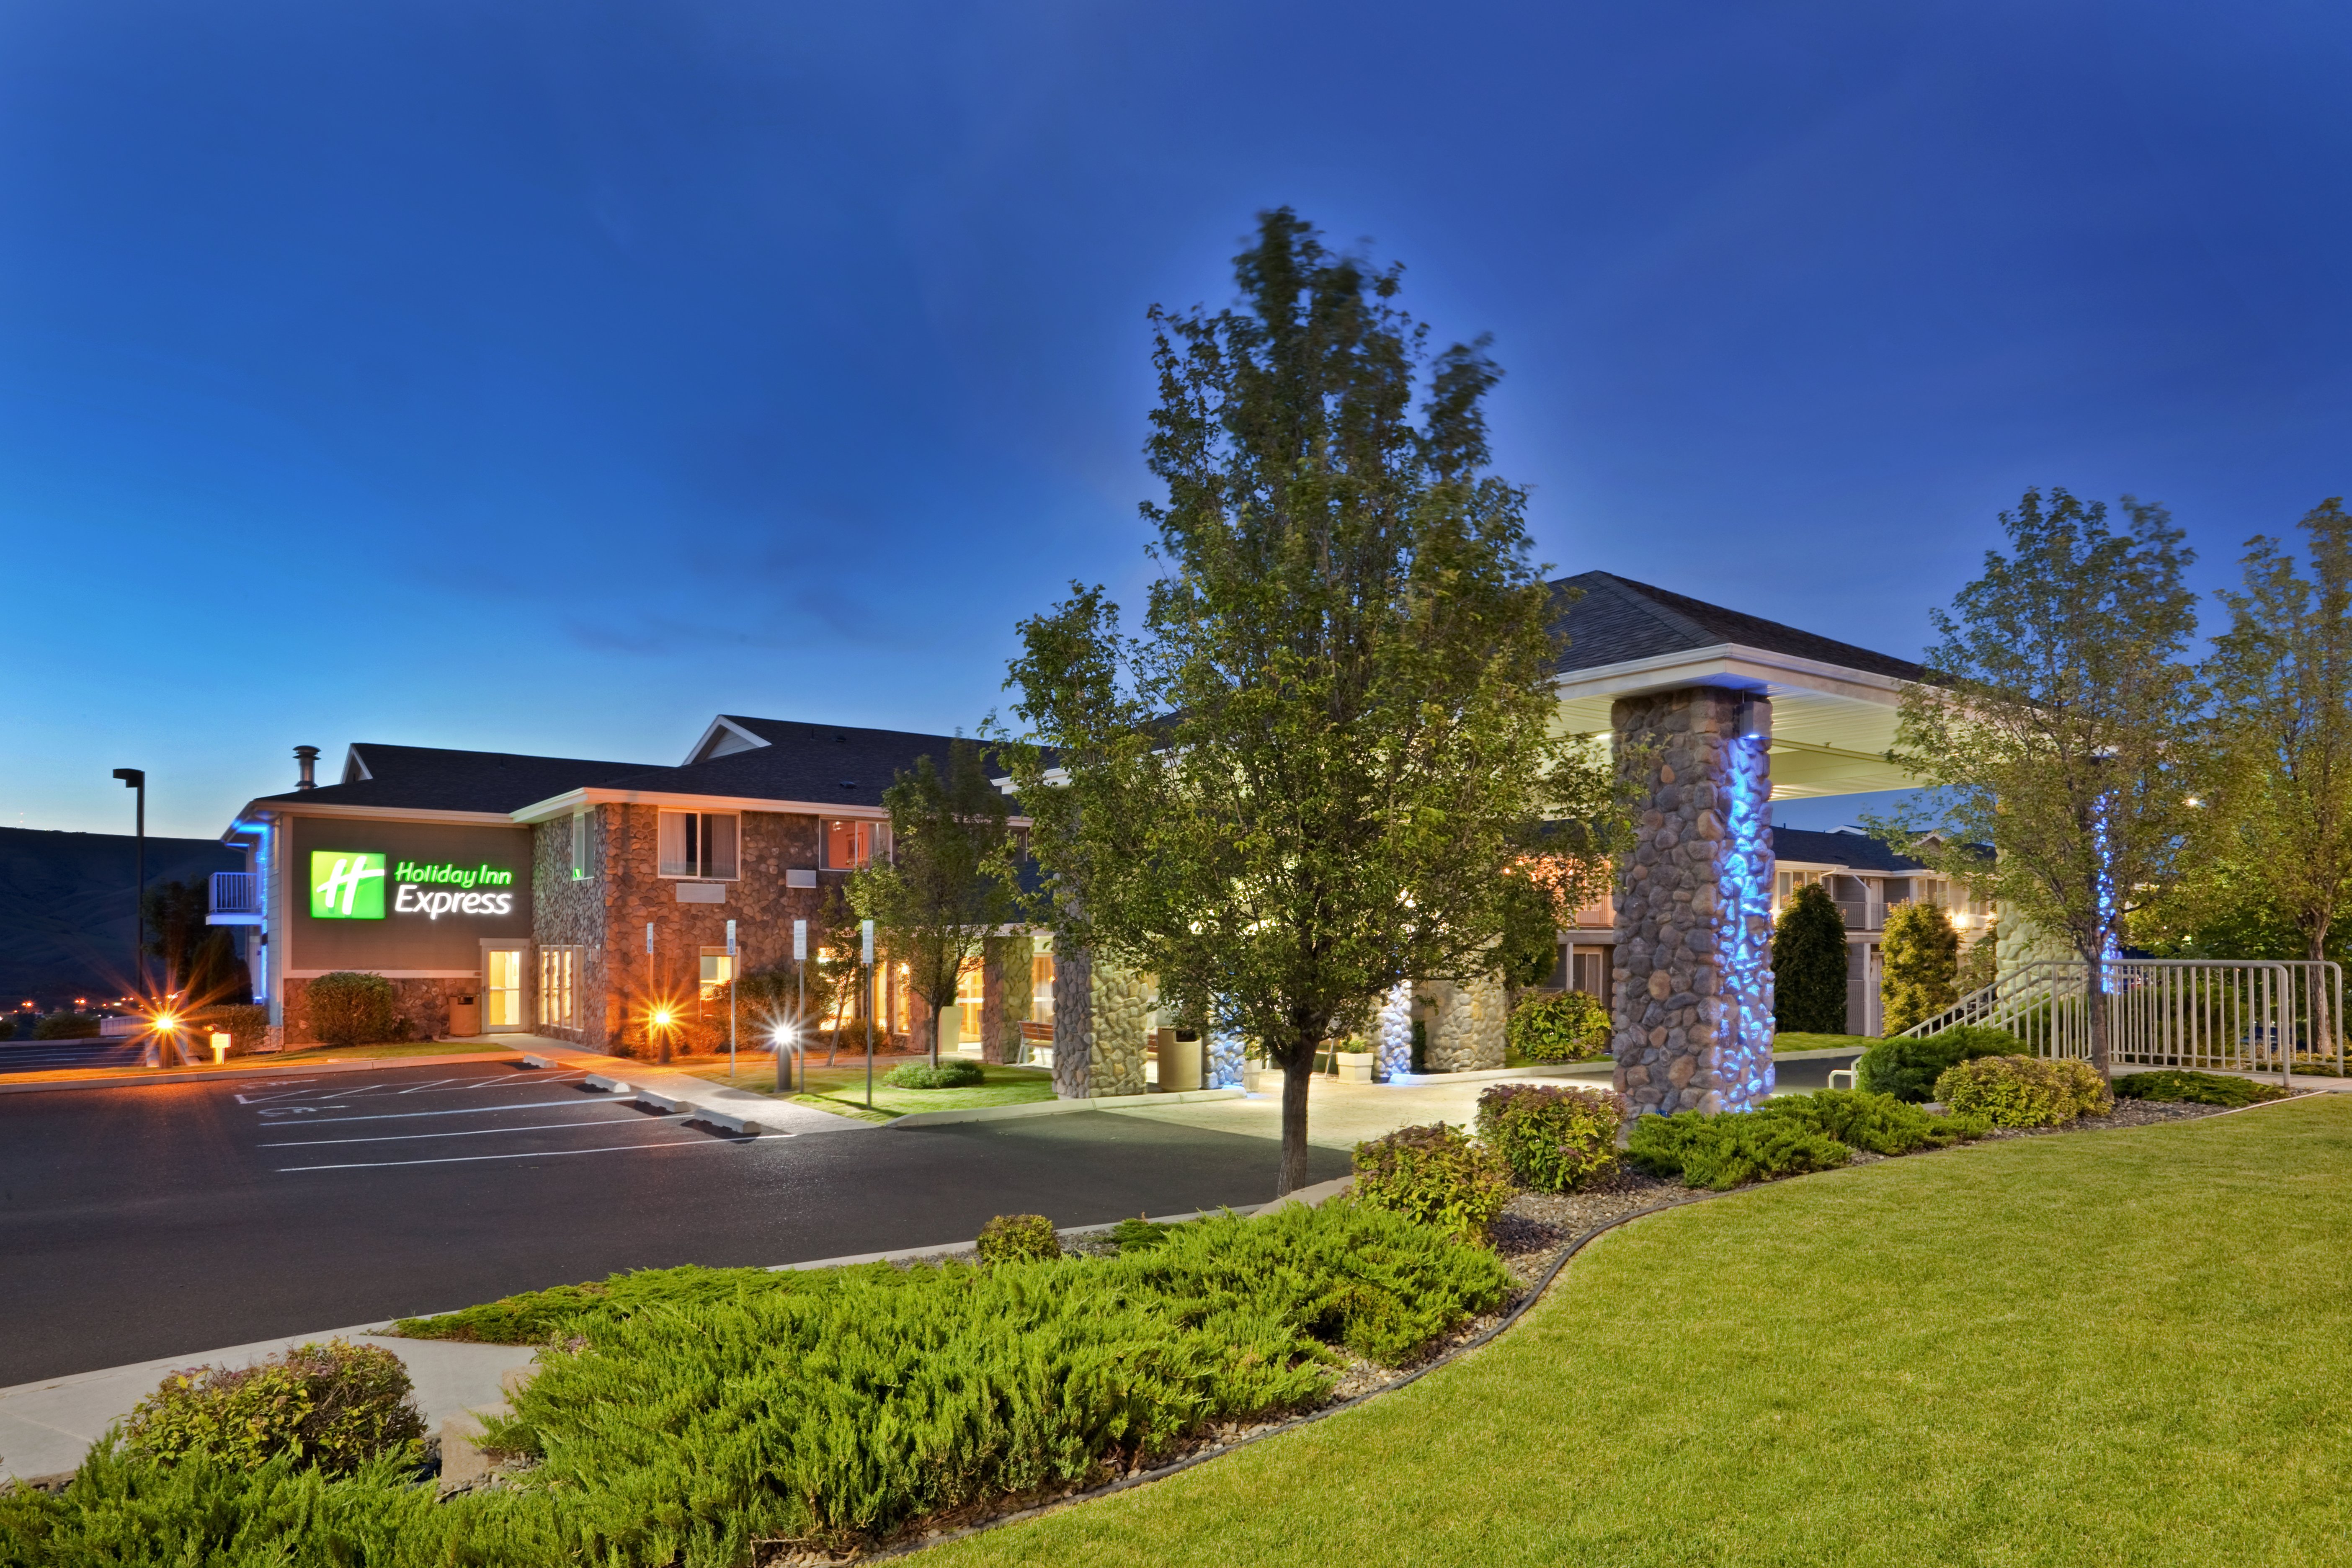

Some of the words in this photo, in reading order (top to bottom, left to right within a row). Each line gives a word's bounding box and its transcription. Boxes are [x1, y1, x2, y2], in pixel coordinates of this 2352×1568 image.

[394, 861, 477, 888] Holiday
[478, 864, 512, 885] Inn
[395, 884, 513, 920] Express
